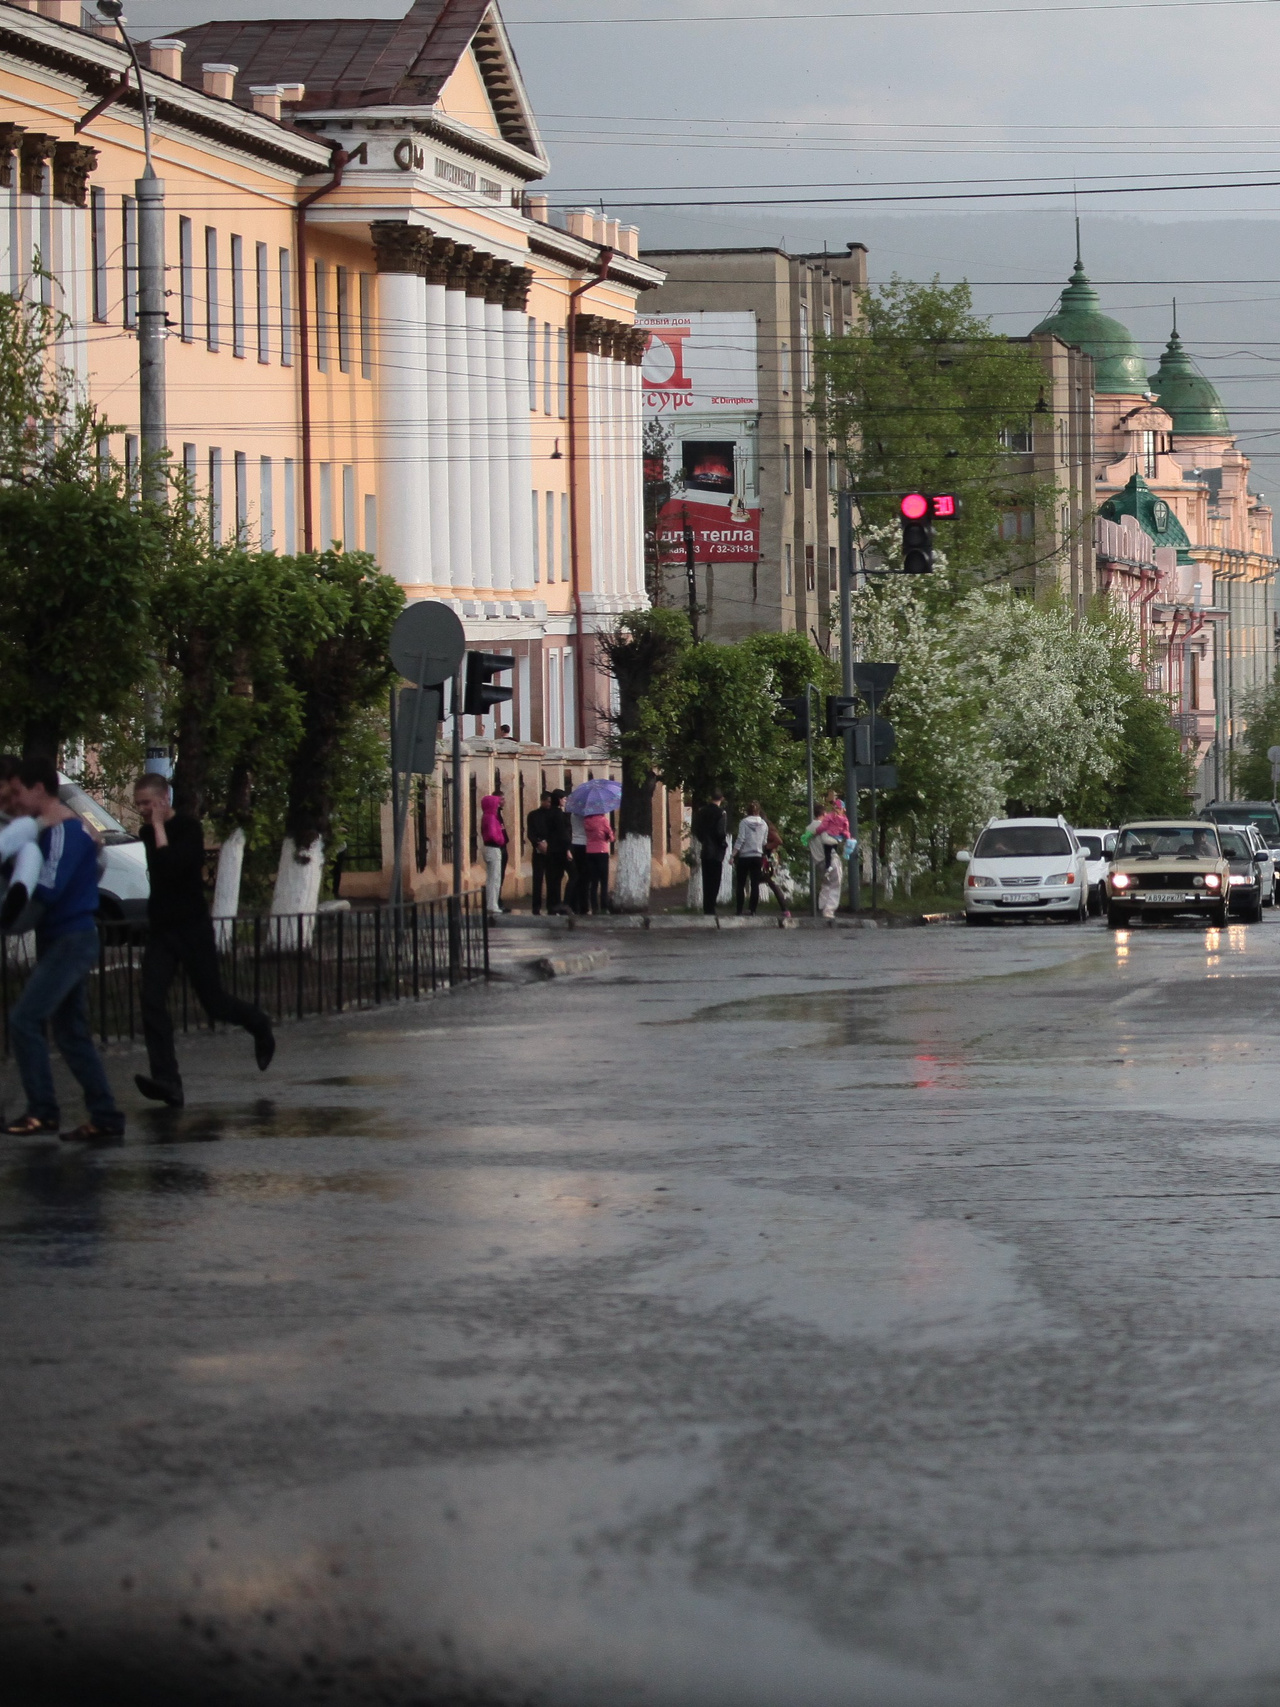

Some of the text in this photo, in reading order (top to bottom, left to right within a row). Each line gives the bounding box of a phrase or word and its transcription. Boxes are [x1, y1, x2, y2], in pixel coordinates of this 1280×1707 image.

[932, 495, 955, 516] 30
[700, 530, 754, 542] тепла
[717, 544, 754, 553] 32-31-31
